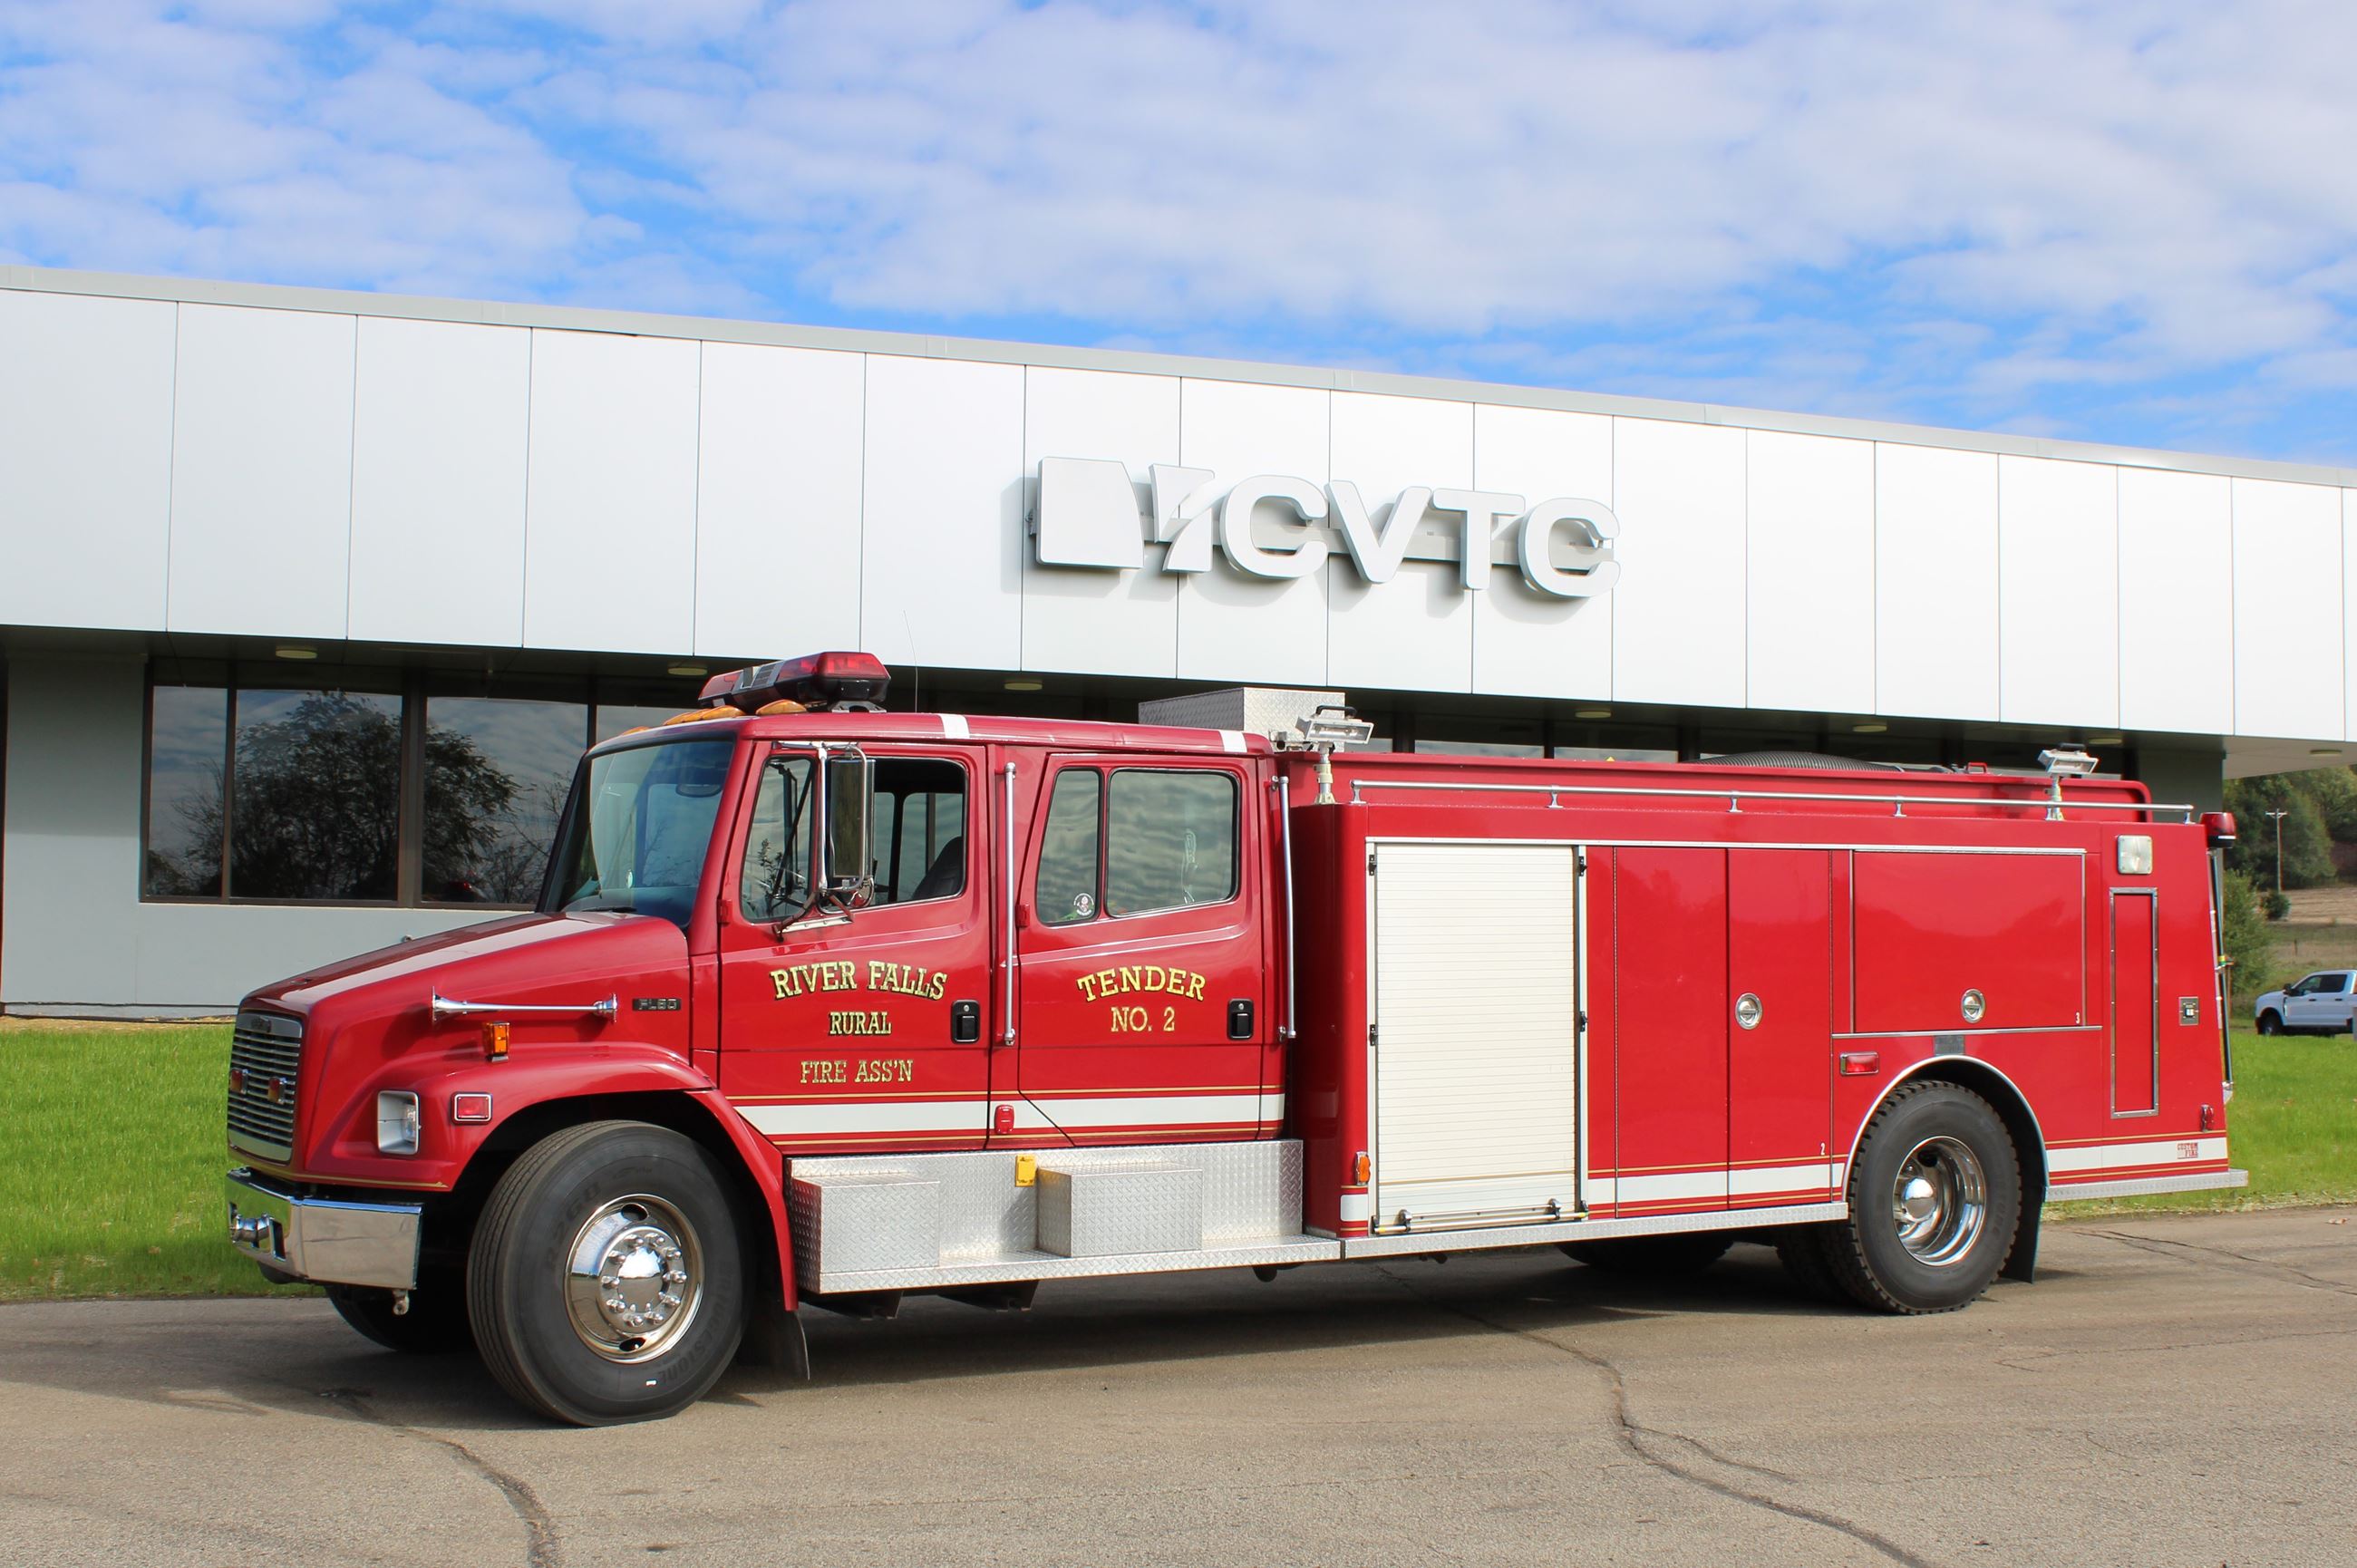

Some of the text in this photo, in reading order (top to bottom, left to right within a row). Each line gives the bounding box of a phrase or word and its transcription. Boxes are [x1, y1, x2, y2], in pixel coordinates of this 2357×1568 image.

[1218, 474, 1621, 597] CVTC
[770, 961, 948, 1001] RIVER FALLS
[1076, 965, 1206, 1002] TENDER
[829, 1011, 891, 1035] RURAL
[1111, 1006, 1175, 1032] NO. 2
[2075, 1011, 2081, 1024] 3
[800, 1060, 914, 1083] FIRE ASS'N
[1820, 1142, 1826, 1156] 2
